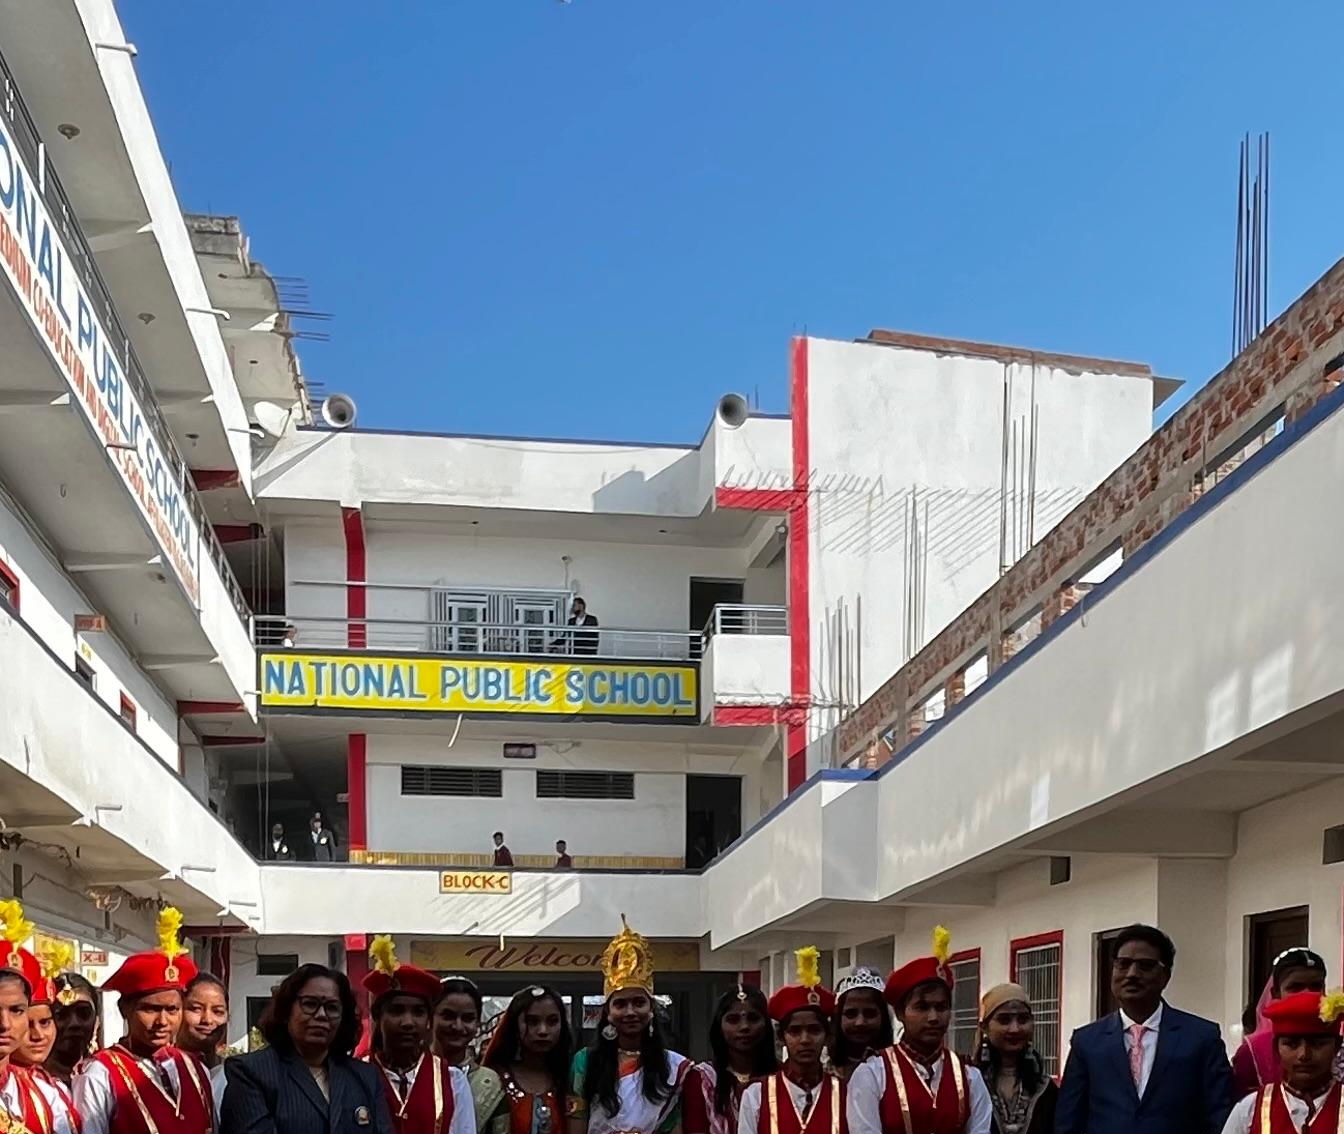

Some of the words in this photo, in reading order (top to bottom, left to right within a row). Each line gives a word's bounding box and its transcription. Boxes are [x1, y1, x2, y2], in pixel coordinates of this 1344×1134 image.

[77, 287, 144, 469] PUBLIC
[145, 438, 194, 569] SCHOOL
[265, 659, 427, 699] NATIONAL
[440, 665, 551, 702] PUBLIC
[566, 669, 693, 706] SCHOOL
[443, 874, 509, 890] BLOCK-C
[464, 942, 603, 969] Welco
